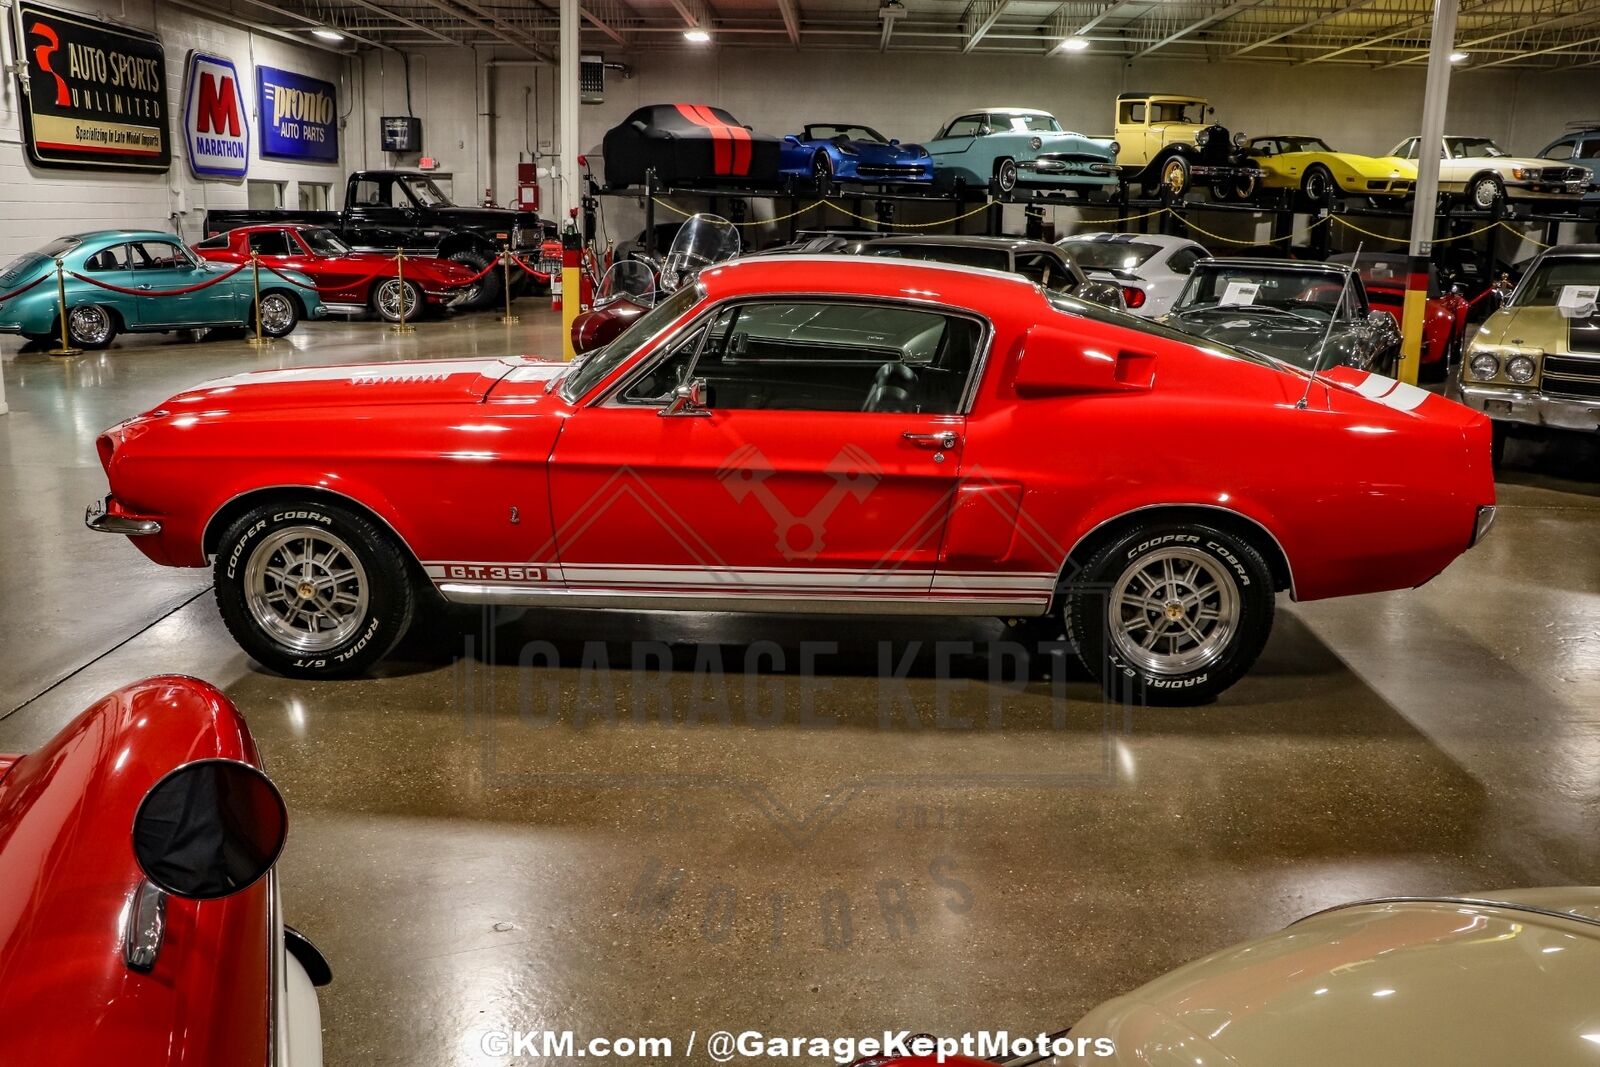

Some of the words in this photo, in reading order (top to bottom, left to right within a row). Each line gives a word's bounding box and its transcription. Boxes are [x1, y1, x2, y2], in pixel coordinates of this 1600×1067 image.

[68, 43, 107, 84] AUTO
[109, 51, 160, 93] SPORTS
[71, 88, 160, 119] UNLIMITED
[197, 72, 241, 137] M
[273, 86, 334, 127] pronto
[75, 126, 108, 144] Specializing
[114, 132, 126, 143] Late
[126, 132, 141, 145] Model
[196, 137, 244, 158] MARATHON
[280, 122, 299, 139] AUTO
[303, 126, 325, 142] PARTS
[227, 519, 267, 580] COOPER
[273, 511, 333, 526] COBRA
[1127, 534, 1200, 560] COOPER
[1206, 541, 1251, 586] COBRA
[334, 617, 379, 663] RADIAL
[293, 659, 327, 668] G/T
[1108, 653, 1137, 678] G/T
[1145, 672, 1209, 689] RADIAL
